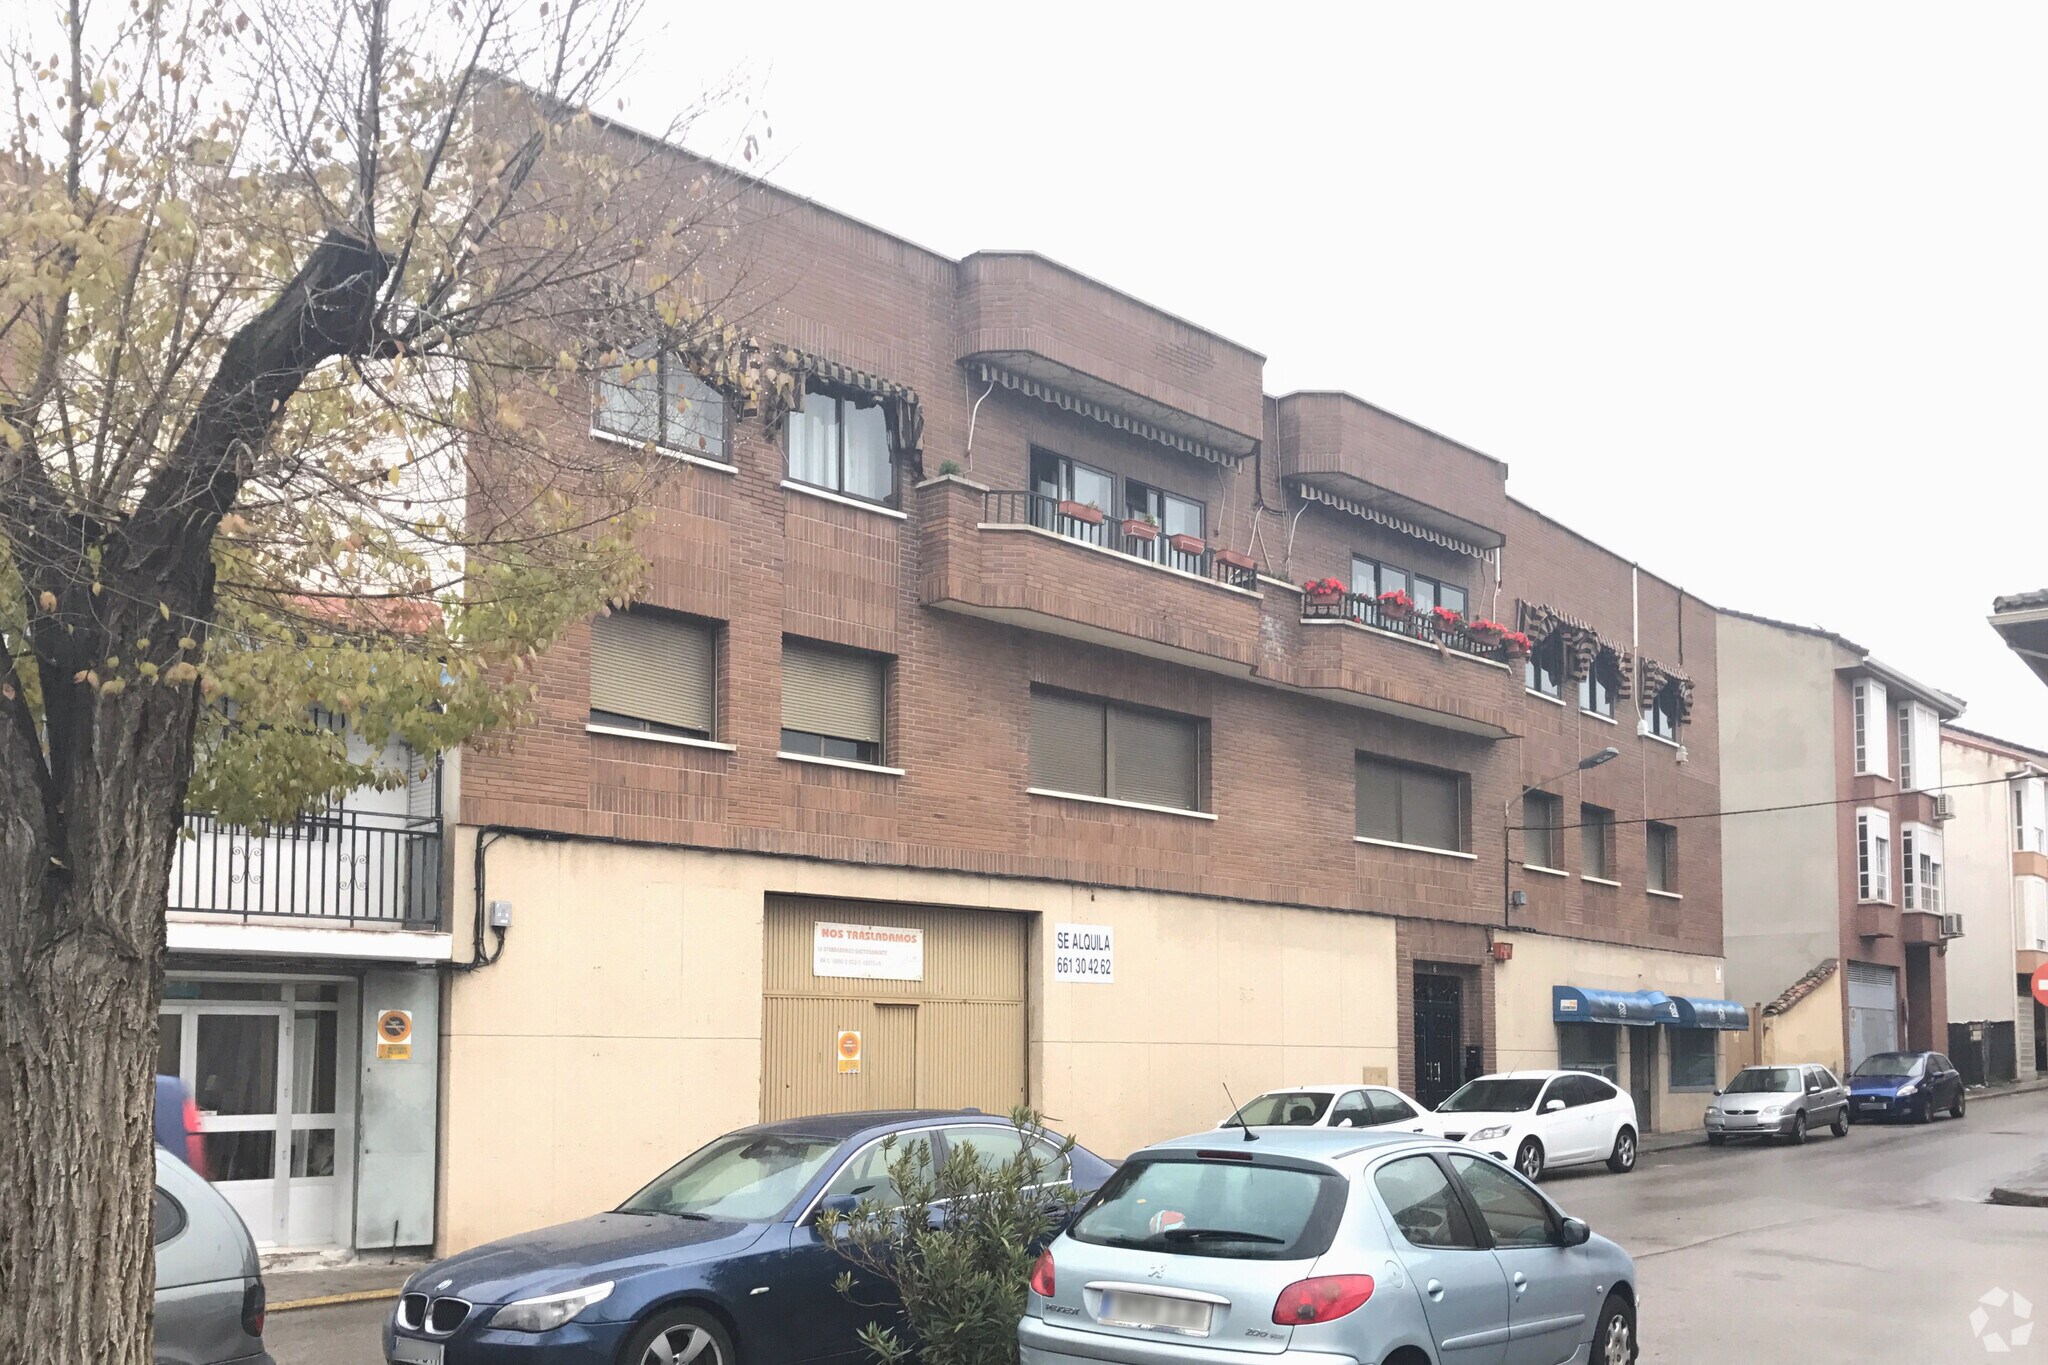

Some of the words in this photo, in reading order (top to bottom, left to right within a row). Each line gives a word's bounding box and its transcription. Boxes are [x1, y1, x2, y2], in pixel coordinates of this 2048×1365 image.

[821, 928, 844, 939] NOS
[846, 930, 918, 944] TRASLADAMOS
[1057, 931, 1070, 950] SE
[1072, 932, 1111, 951] ALQUILA
[1057, 956, 1073, 974] 661
[1075, 957, 1087, 974] 30
[1088, 958, 1099, 975] 42
[1100, 958, 1111, 975] 62
[1045, 1303, 1080, 1316] PEUGEOT
